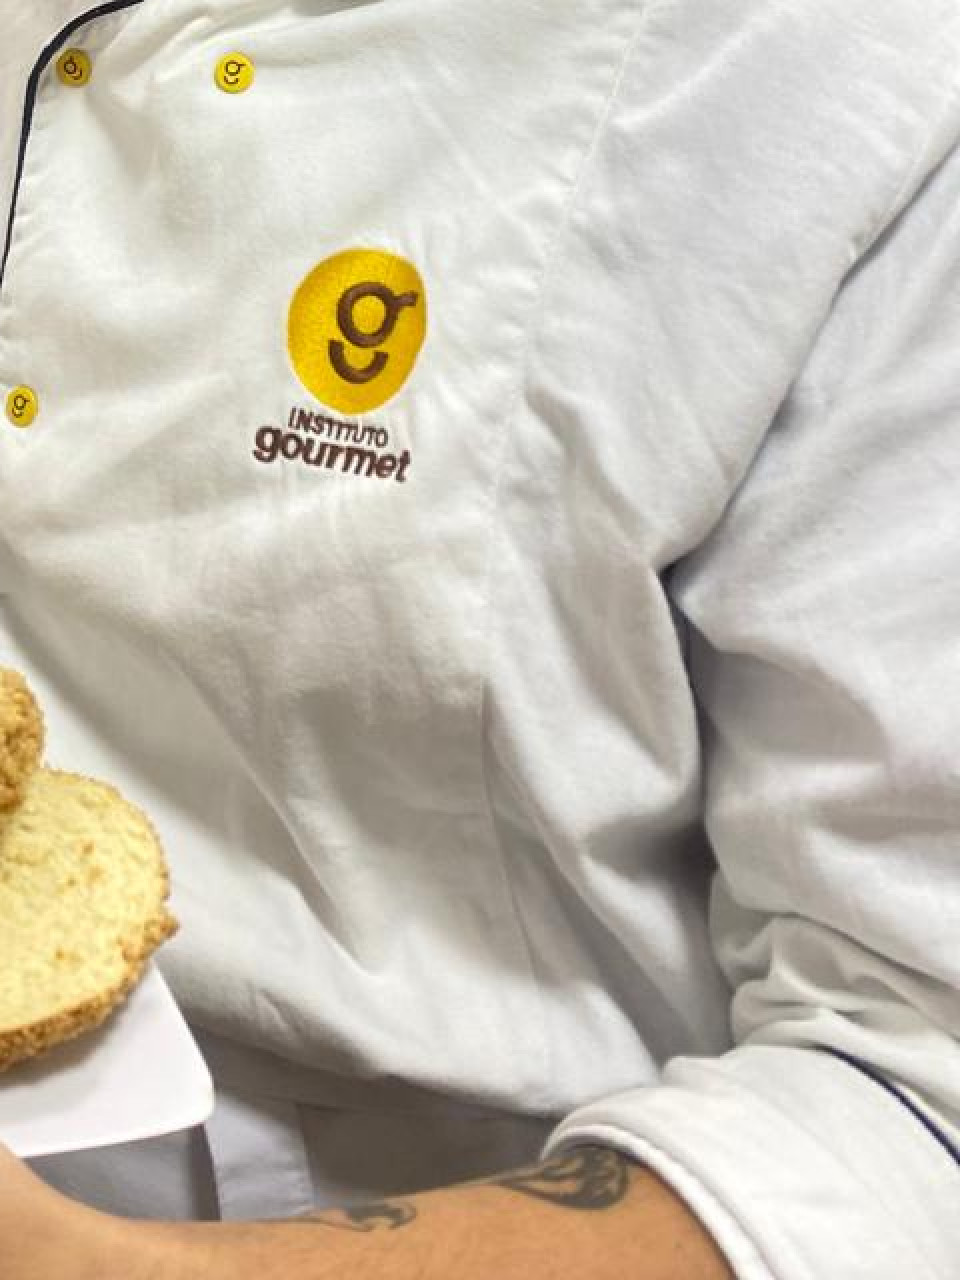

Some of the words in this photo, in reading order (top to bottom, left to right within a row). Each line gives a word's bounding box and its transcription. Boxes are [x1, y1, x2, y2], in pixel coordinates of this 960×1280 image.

[223, 59, 248, 85] g
[328, 281, 418, 384] g
[11, 393, 30, 418] g
[288, 406, 389, 448] INSTITUTO
[251, 425, 411, 482] gourmet
